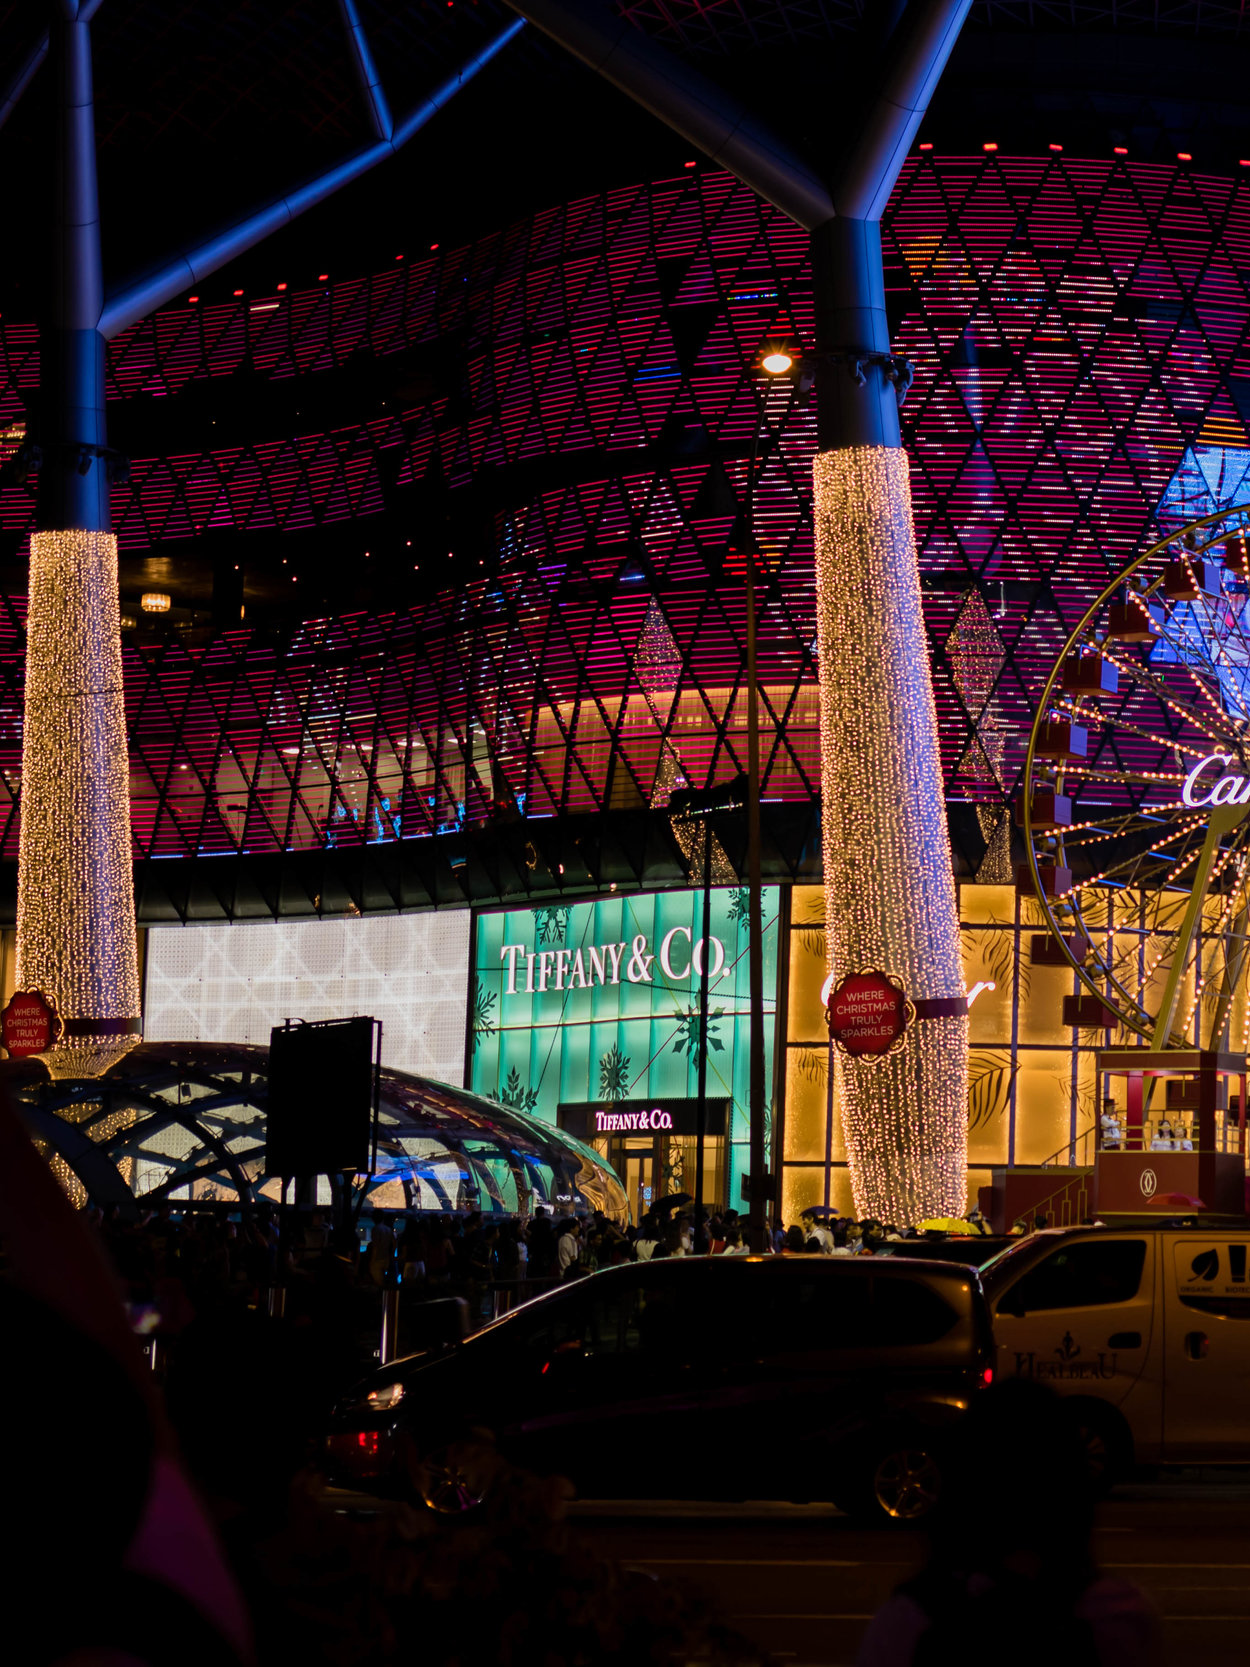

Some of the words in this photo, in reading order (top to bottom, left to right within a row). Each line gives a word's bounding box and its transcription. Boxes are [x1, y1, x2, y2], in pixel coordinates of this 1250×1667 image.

[500, 942, 627, 995] TIFFANY
[845, 990, 885, 1002] WHERE
[14, 1008, 41, 1016] WHERE
[836, 1002, 896, 1015] CHRISTMAS
[6, 1018, 48, 1027] CHRISTMAS
[850, 1015, 883, 1026] TRULY
[16, 1029, 39, 1038] TRULY
[840, 1026, 894, 1039] SPARKLES
[8, 1039, 46, 1048] SPARKLES
[1179, 1286, 1214, 1294] ORGANIC
